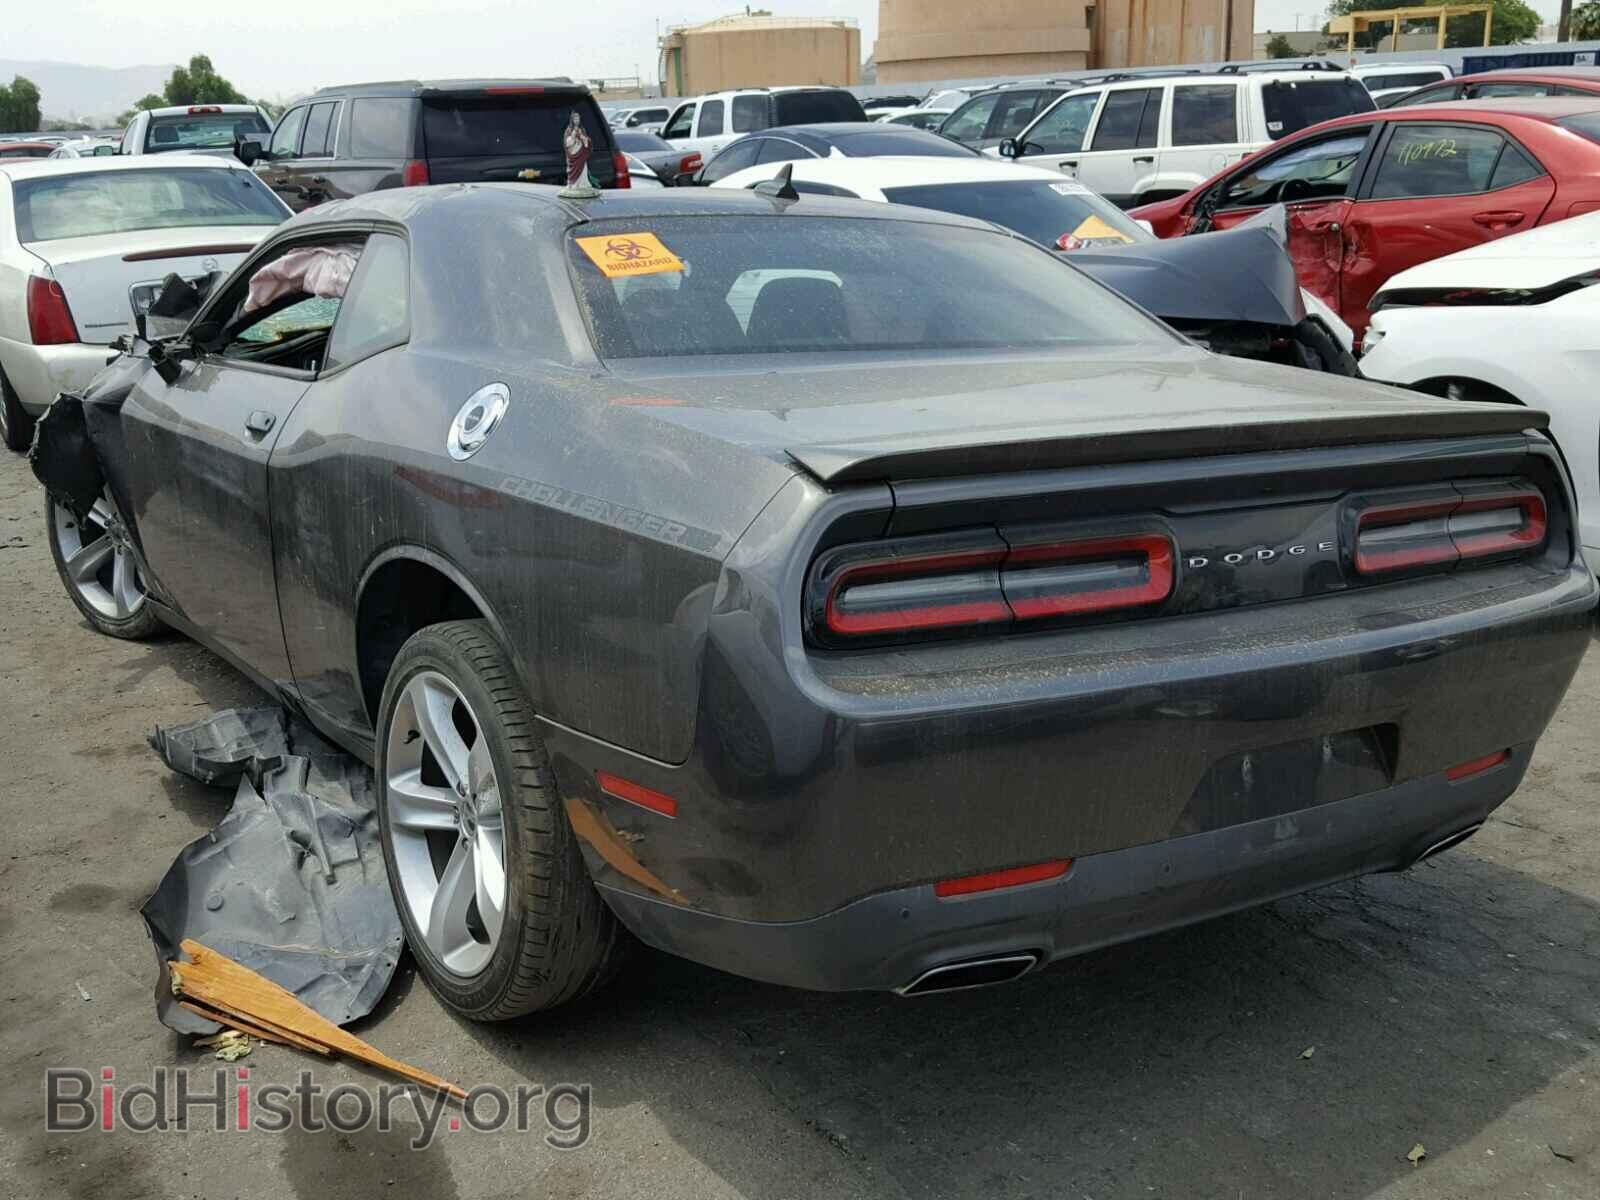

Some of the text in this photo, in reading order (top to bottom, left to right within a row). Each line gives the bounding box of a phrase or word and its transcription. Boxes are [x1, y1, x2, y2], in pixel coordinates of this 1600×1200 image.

[606, 256, 673, 271] BIOHAZARD
[500, 477, 688, 545] CHALLENGER
[1189, 541, 1334, 568] DODGE
